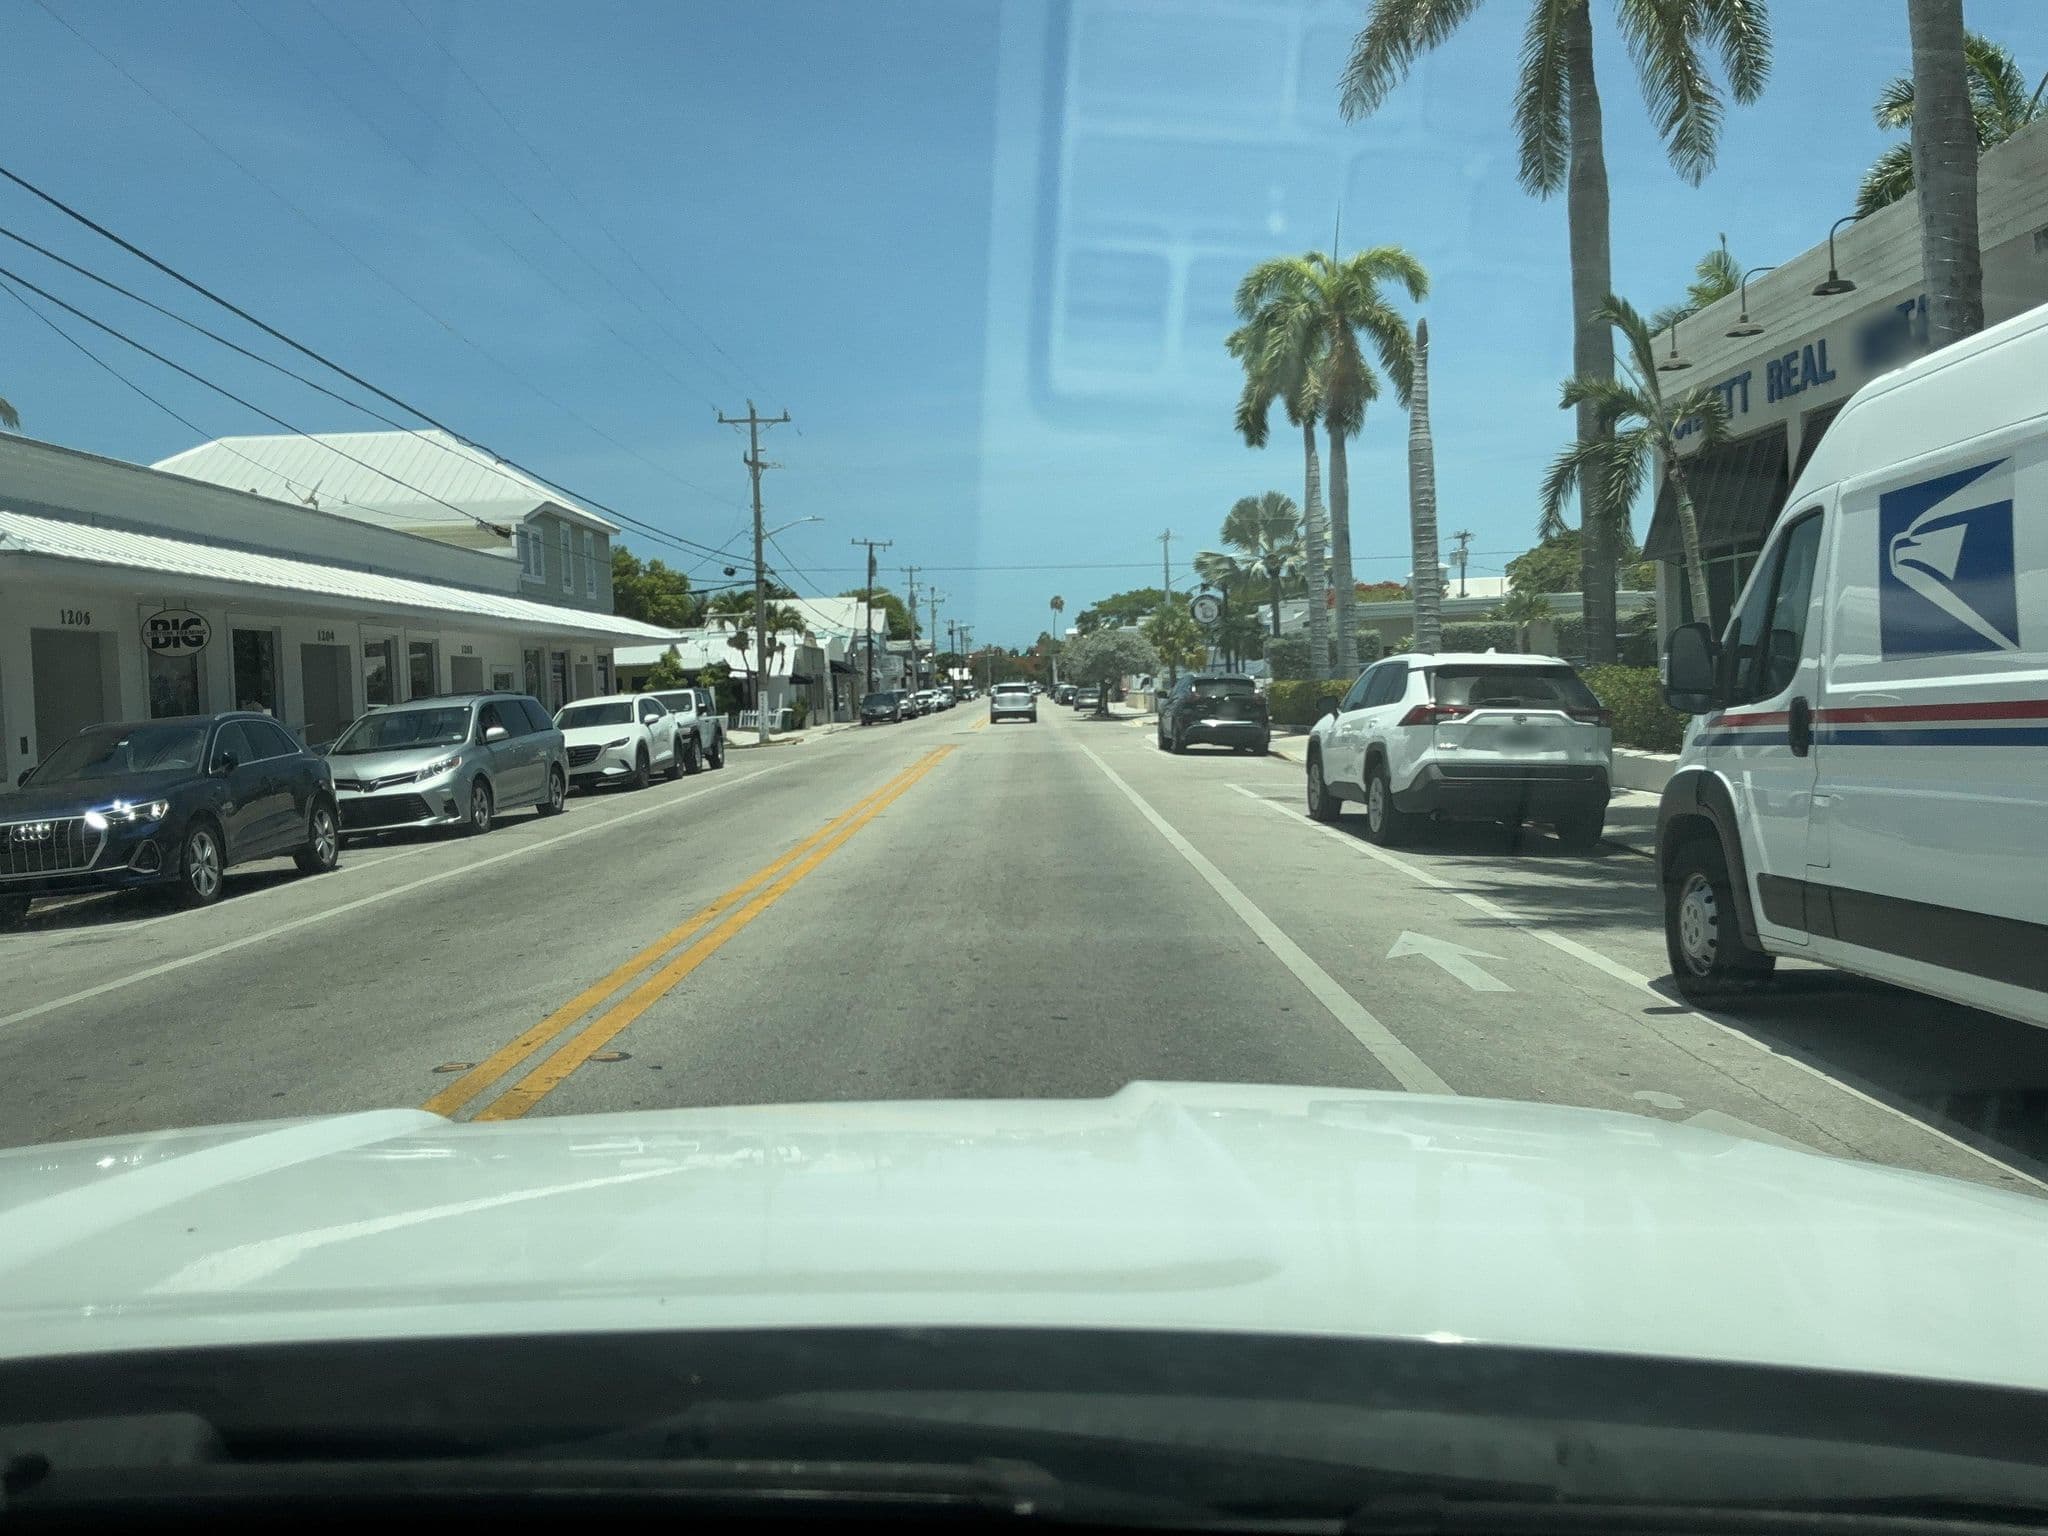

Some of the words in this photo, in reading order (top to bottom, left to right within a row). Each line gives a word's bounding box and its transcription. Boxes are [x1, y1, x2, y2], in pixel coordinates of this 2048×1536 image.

[1766, 338, 1836, 404] REAL
[61, 608, 91, 626] 1206
[150, 617, 204, 649] BIG
[317, 629, 335, 642] 1204
